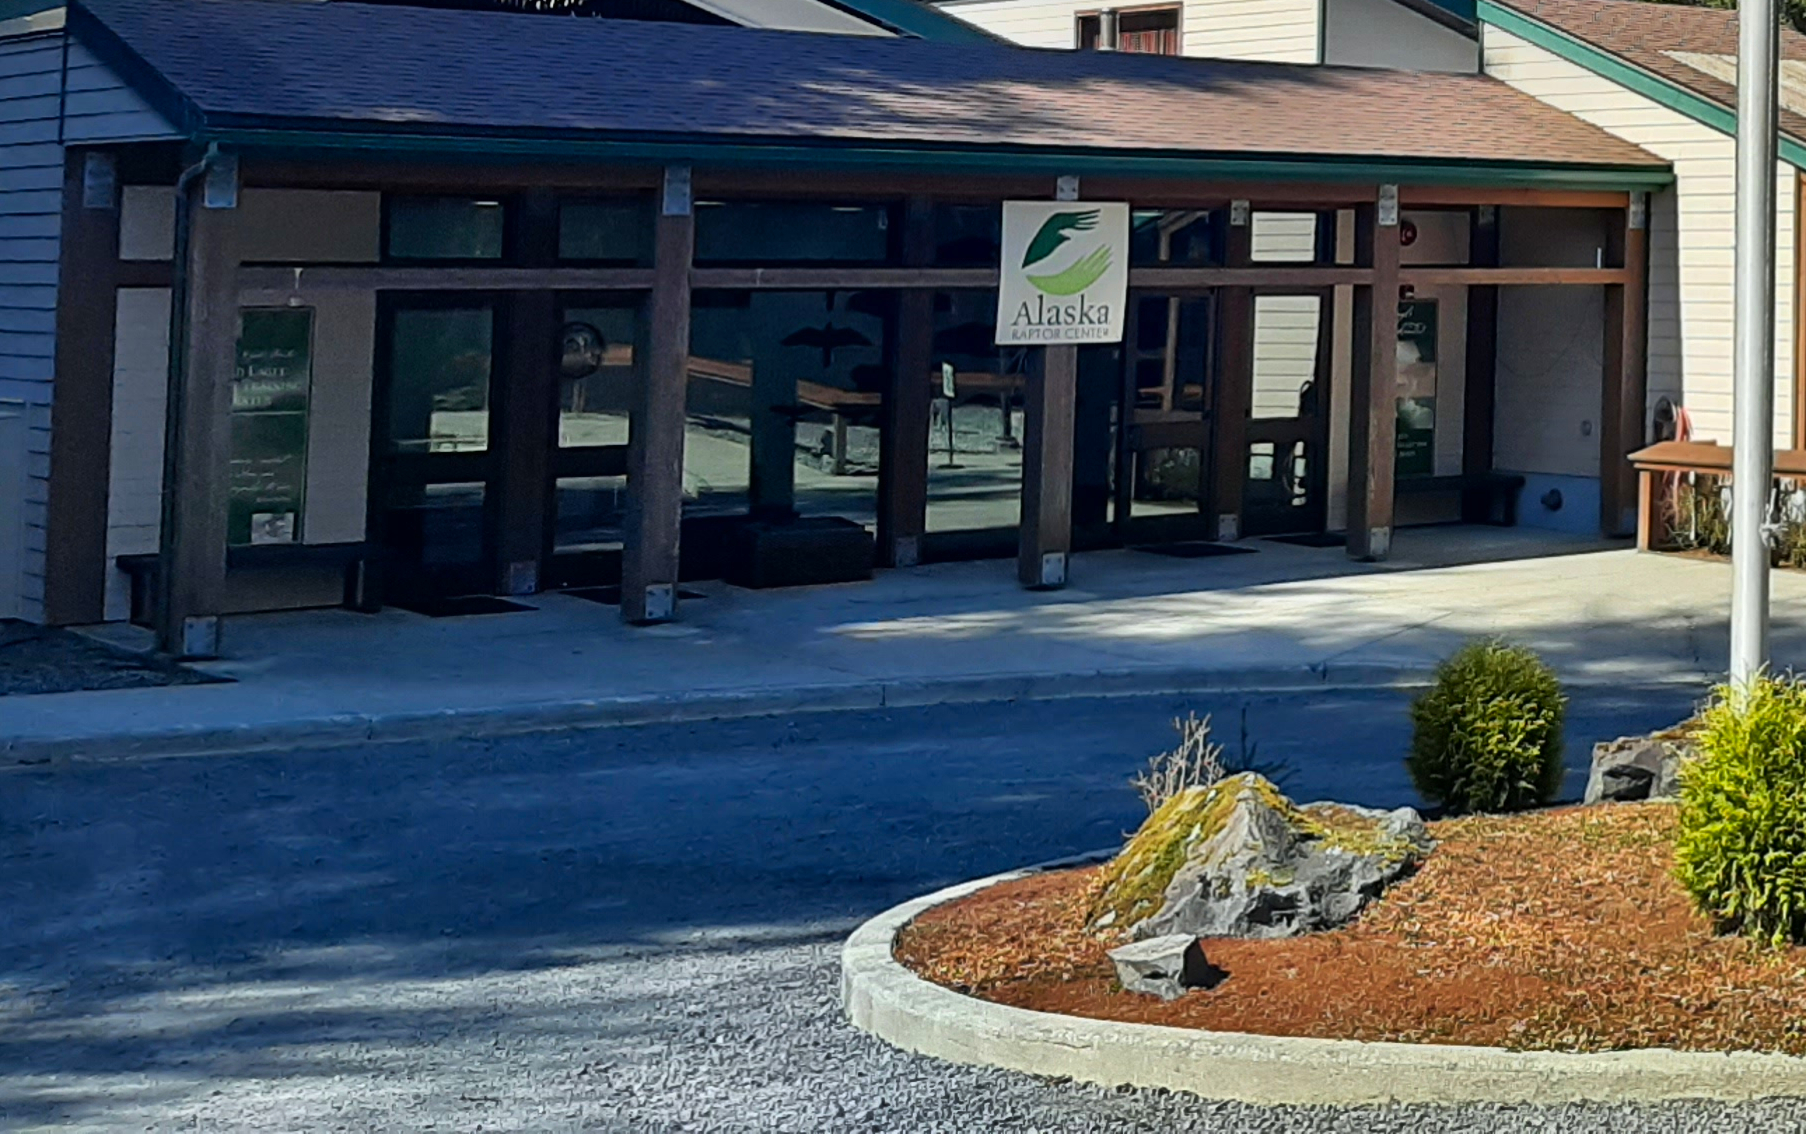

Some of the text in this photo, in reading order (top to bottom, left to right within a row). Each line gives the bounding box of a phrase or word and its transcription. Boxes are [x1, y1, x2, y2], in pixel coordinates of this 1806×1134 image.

[1011, 294, 1110, 326] Alaska
[1011, 327, 1110, 341] RAPTOR CENTER
